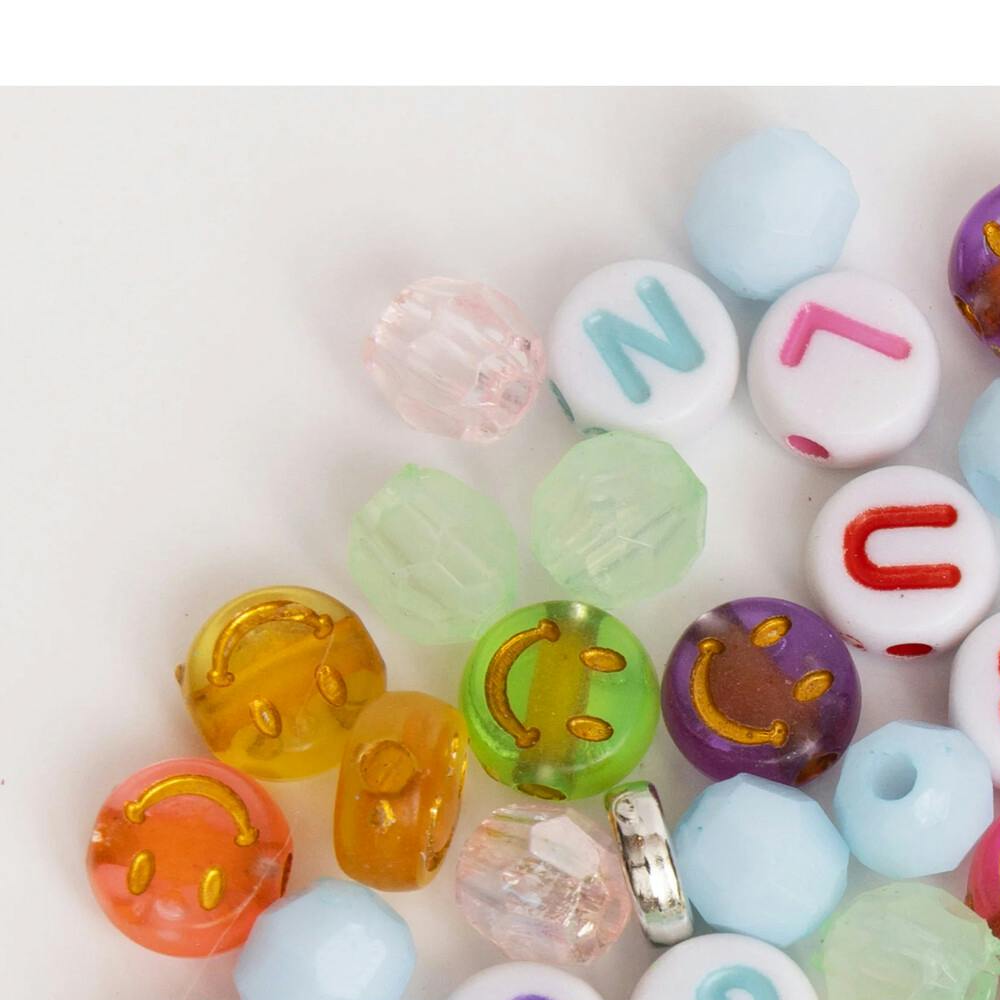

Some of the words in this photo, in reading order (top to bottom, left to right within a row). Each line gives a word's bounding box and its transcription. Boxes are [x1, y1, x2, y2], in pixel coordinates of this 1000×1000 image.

[584, 276, 704, 404] N
[780, 303, 911, 367] L
[842, 503, 961, 592] U
